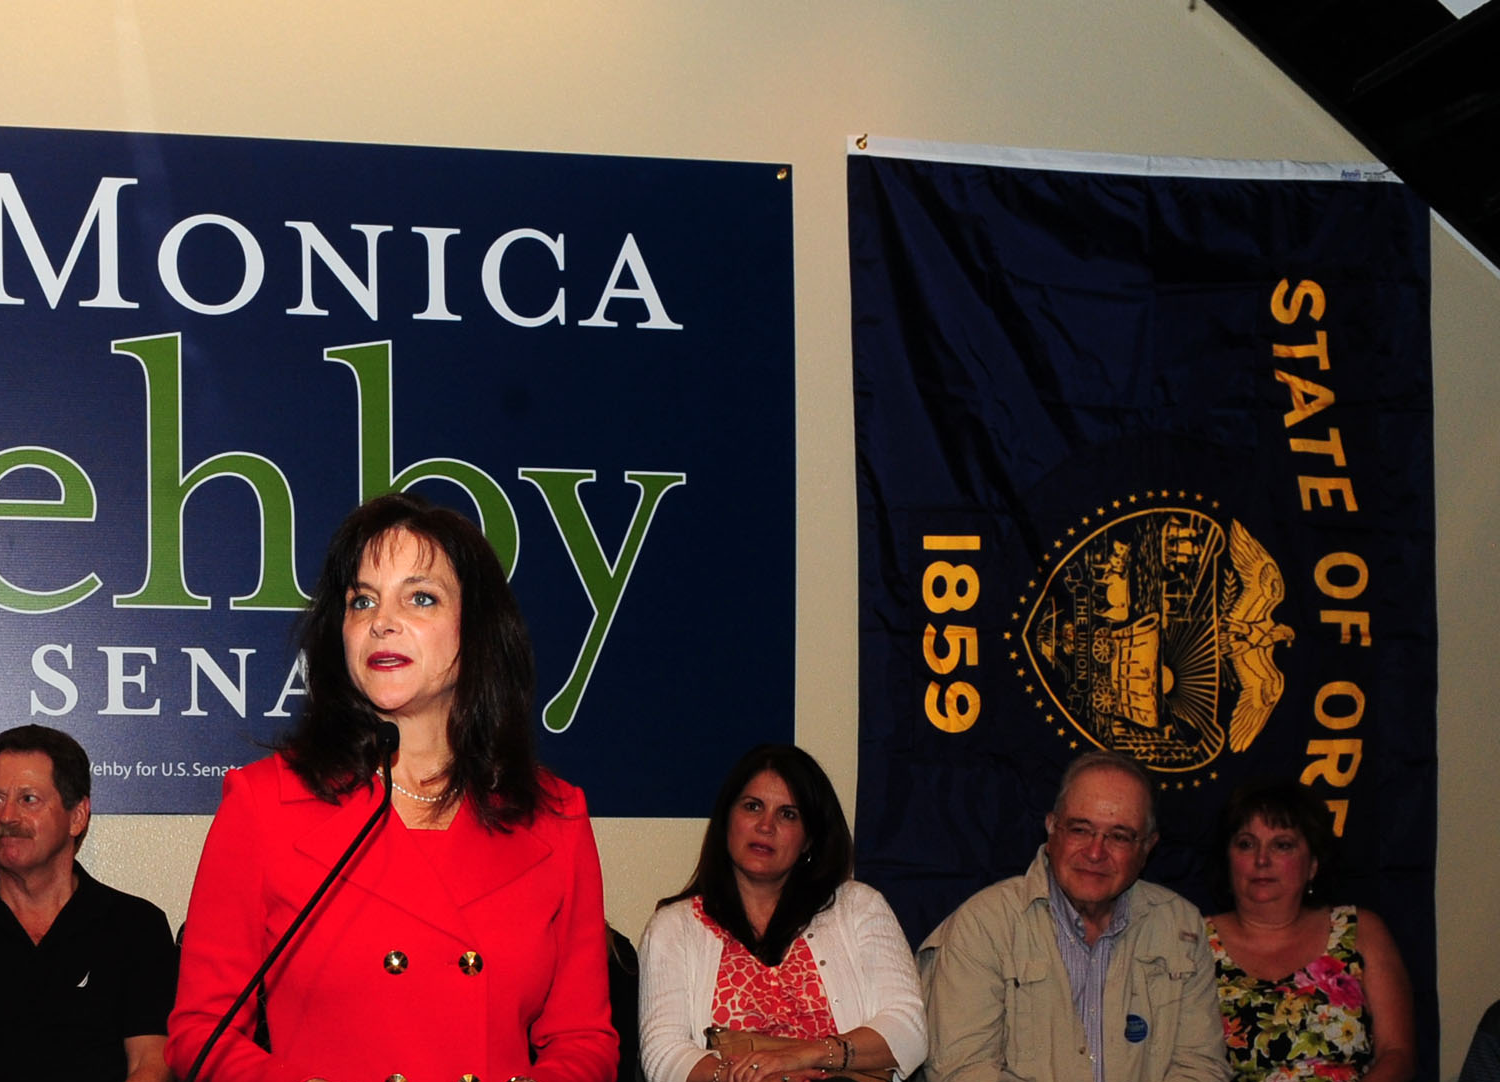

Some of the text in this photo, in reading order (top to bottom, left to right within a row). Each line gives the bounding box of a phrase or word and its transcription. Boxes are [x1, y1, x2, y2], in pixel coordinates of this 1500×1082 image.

[1270, 278, 1358, 512] STATE
[921, 534, 982, 734] 1859
[1076, 596, 1088, 625] THE
[1313, 552, 1372, 647] OF
[29, 642, 314, 718] SENA
[89, 761, 133, 780] ehby
[136, 761, 157, 776] for
[161, 762, 190, 777] U.S.
